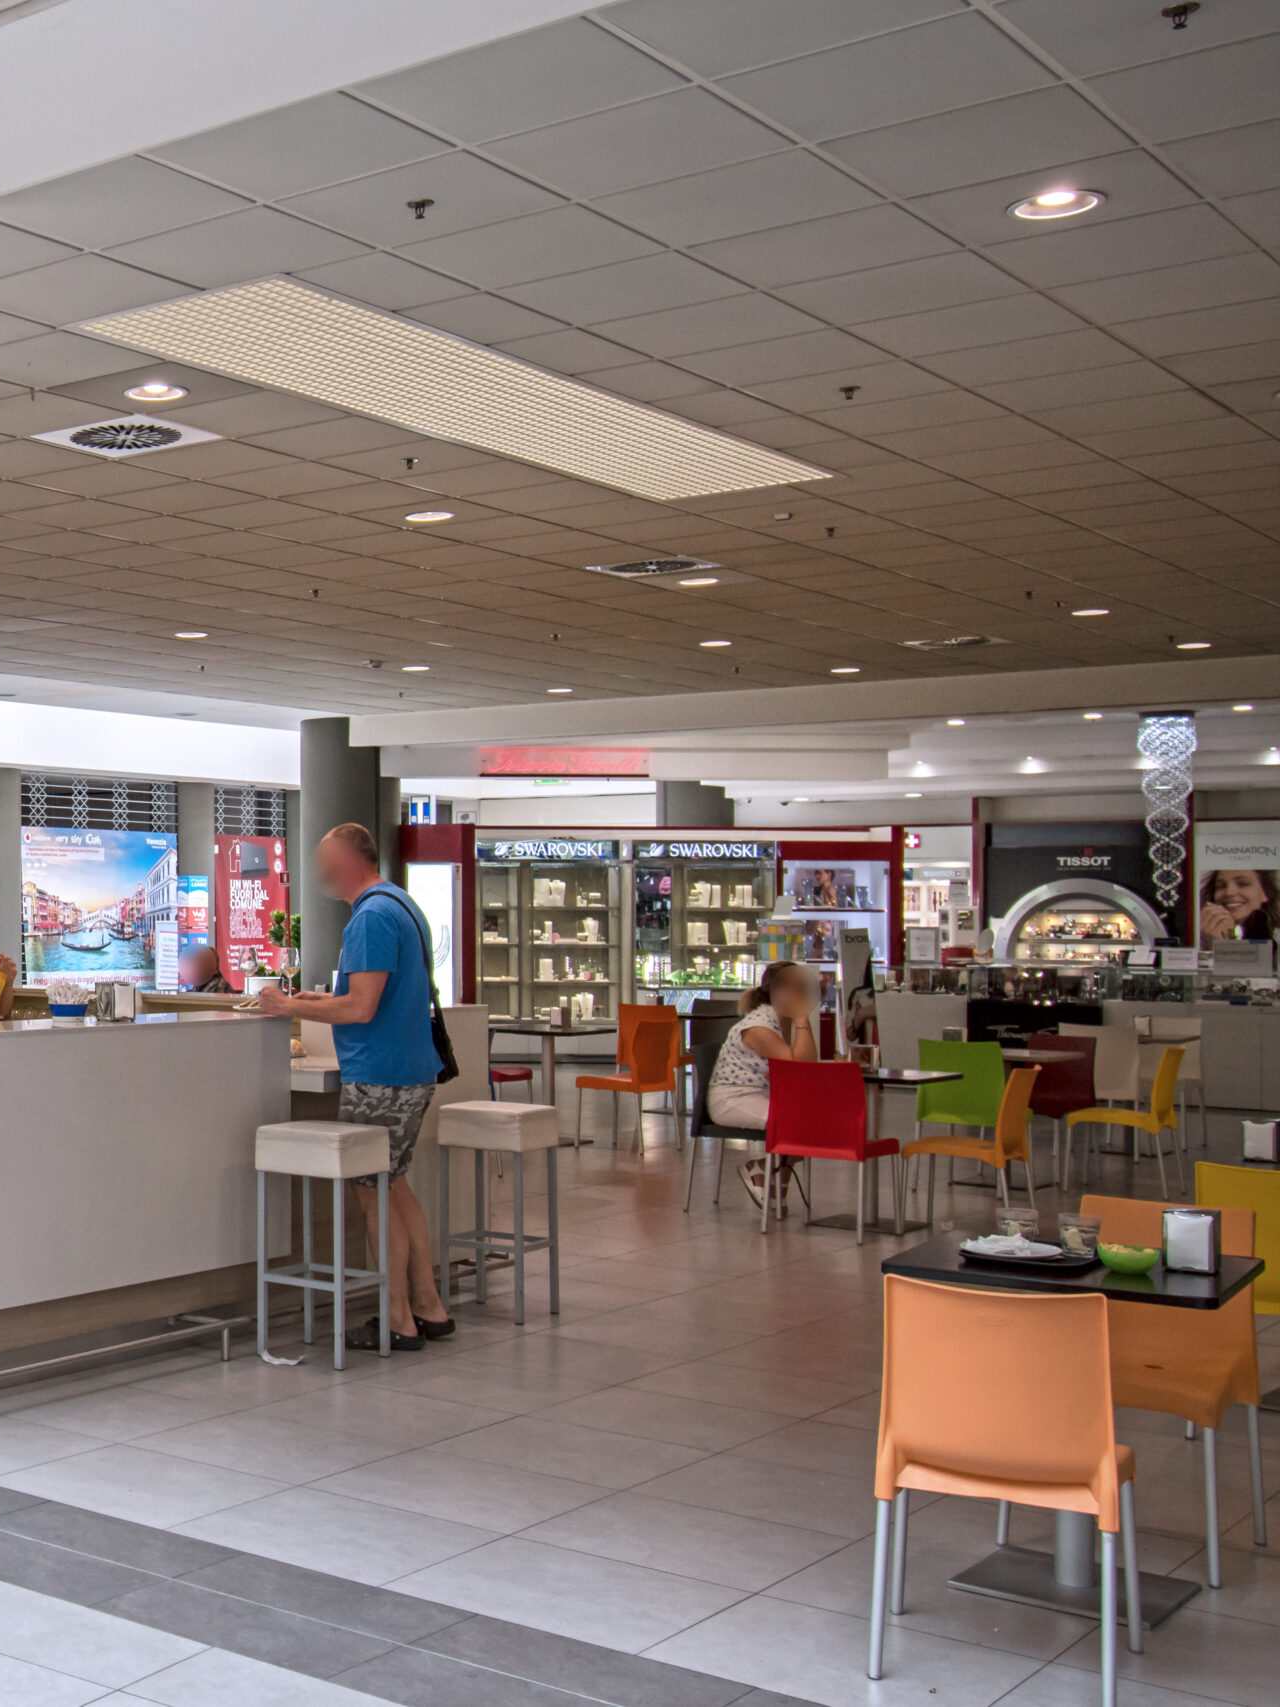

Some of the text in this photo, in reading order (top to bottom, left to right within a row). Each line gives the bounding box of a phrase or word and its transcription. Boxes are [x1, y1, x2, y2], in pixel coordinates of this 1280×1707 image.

[514, 842, 603, 857] SWAROVSKI
[669, 843, 758, 858] SWAROVSKI
[1205, 844, 1278, 857] NOMINATION
[1056, 856, 1111, 867] TISSOT
[230, 879, 262, 890] UN WI-FI
[230, 889, 269, 900] FUORI DAL
[230, 899, 265, 910] COMUNE.
